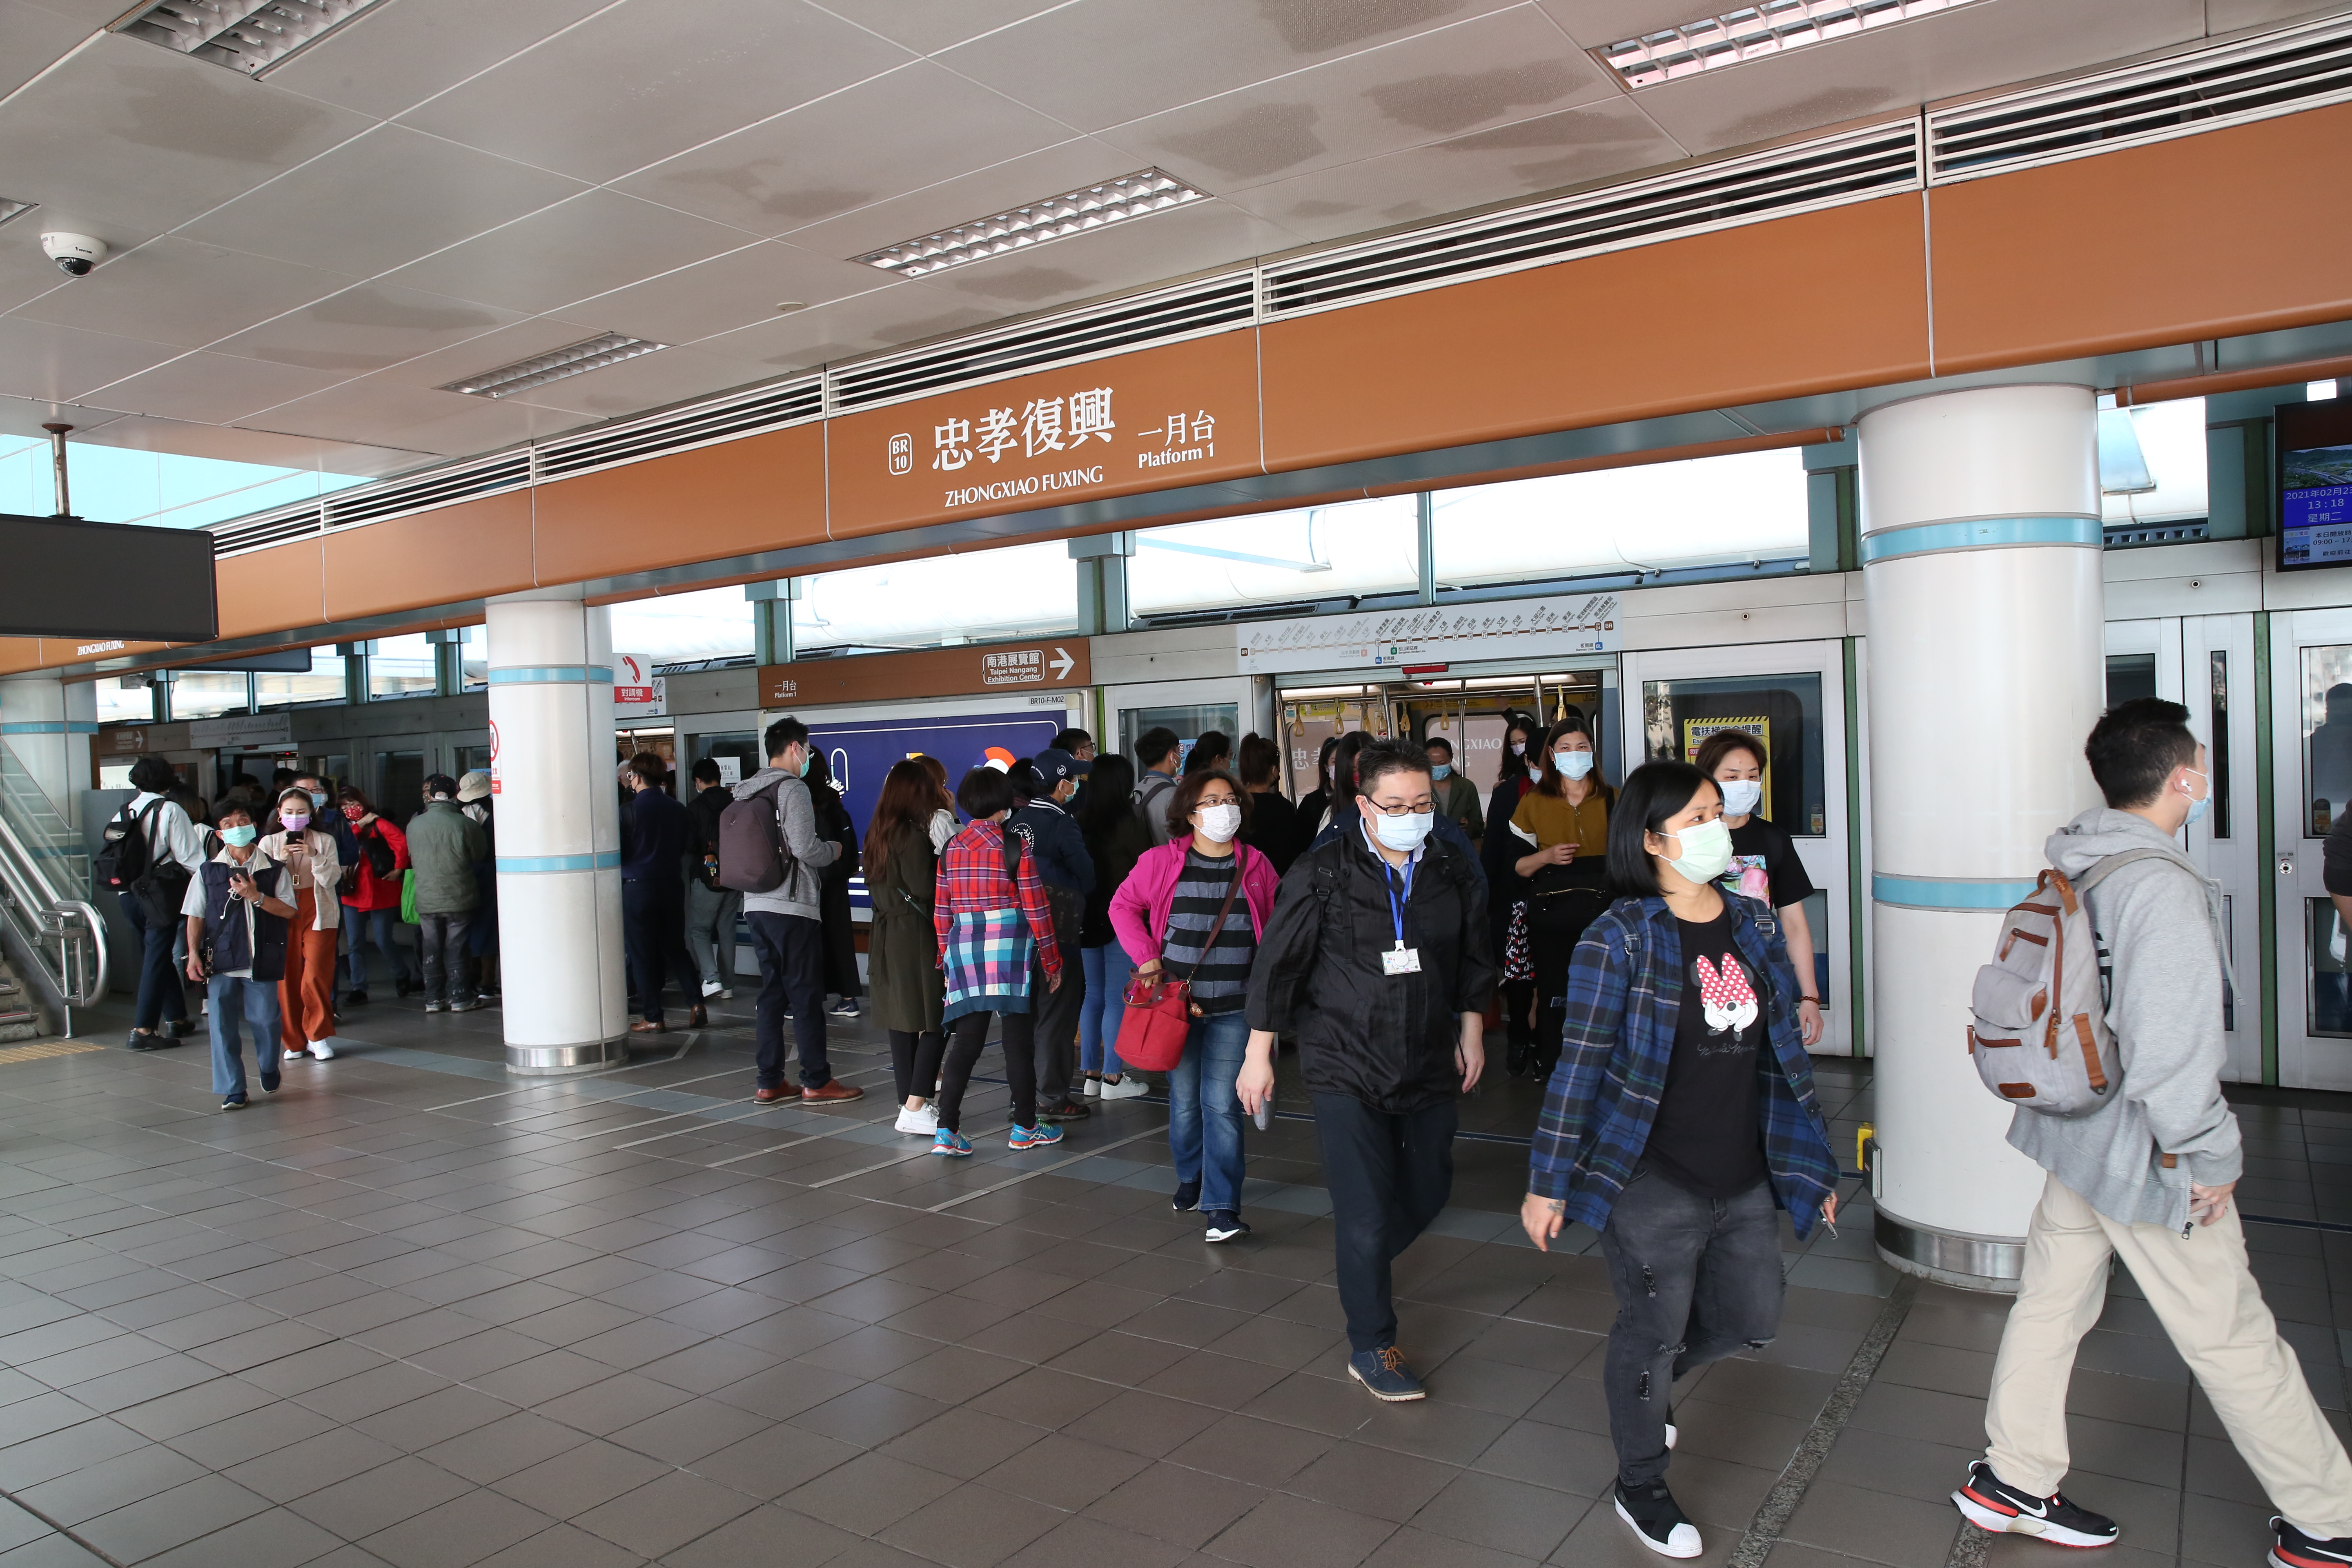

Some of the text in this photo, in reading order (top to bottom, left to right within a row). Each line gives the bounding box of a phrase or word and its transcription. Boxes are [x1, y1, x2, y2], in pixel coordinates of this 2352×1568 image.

[932, 386, 1116, 471] 忠孝復興
[1138, 410, 1215, 447] 一月台
[892, 439, 909, 454] BR
[894, 455, 907, 470] 10
[1138, 442, 1214, 469] Platform 1
[944, 466, 1103, 507] ZHONGXIAO FUXING
[2307, 512, 2342, 523] 星期二
[77, 640, 125, 656] ZHONGXIAO FUXING
[987, 653, 1040, 668] 南港展覽館
[621, 688, 643, 697] 對講機
[775, 680, 797, 691] 一月台
[1031, 696, 1064, 704] BR10-F-M02
